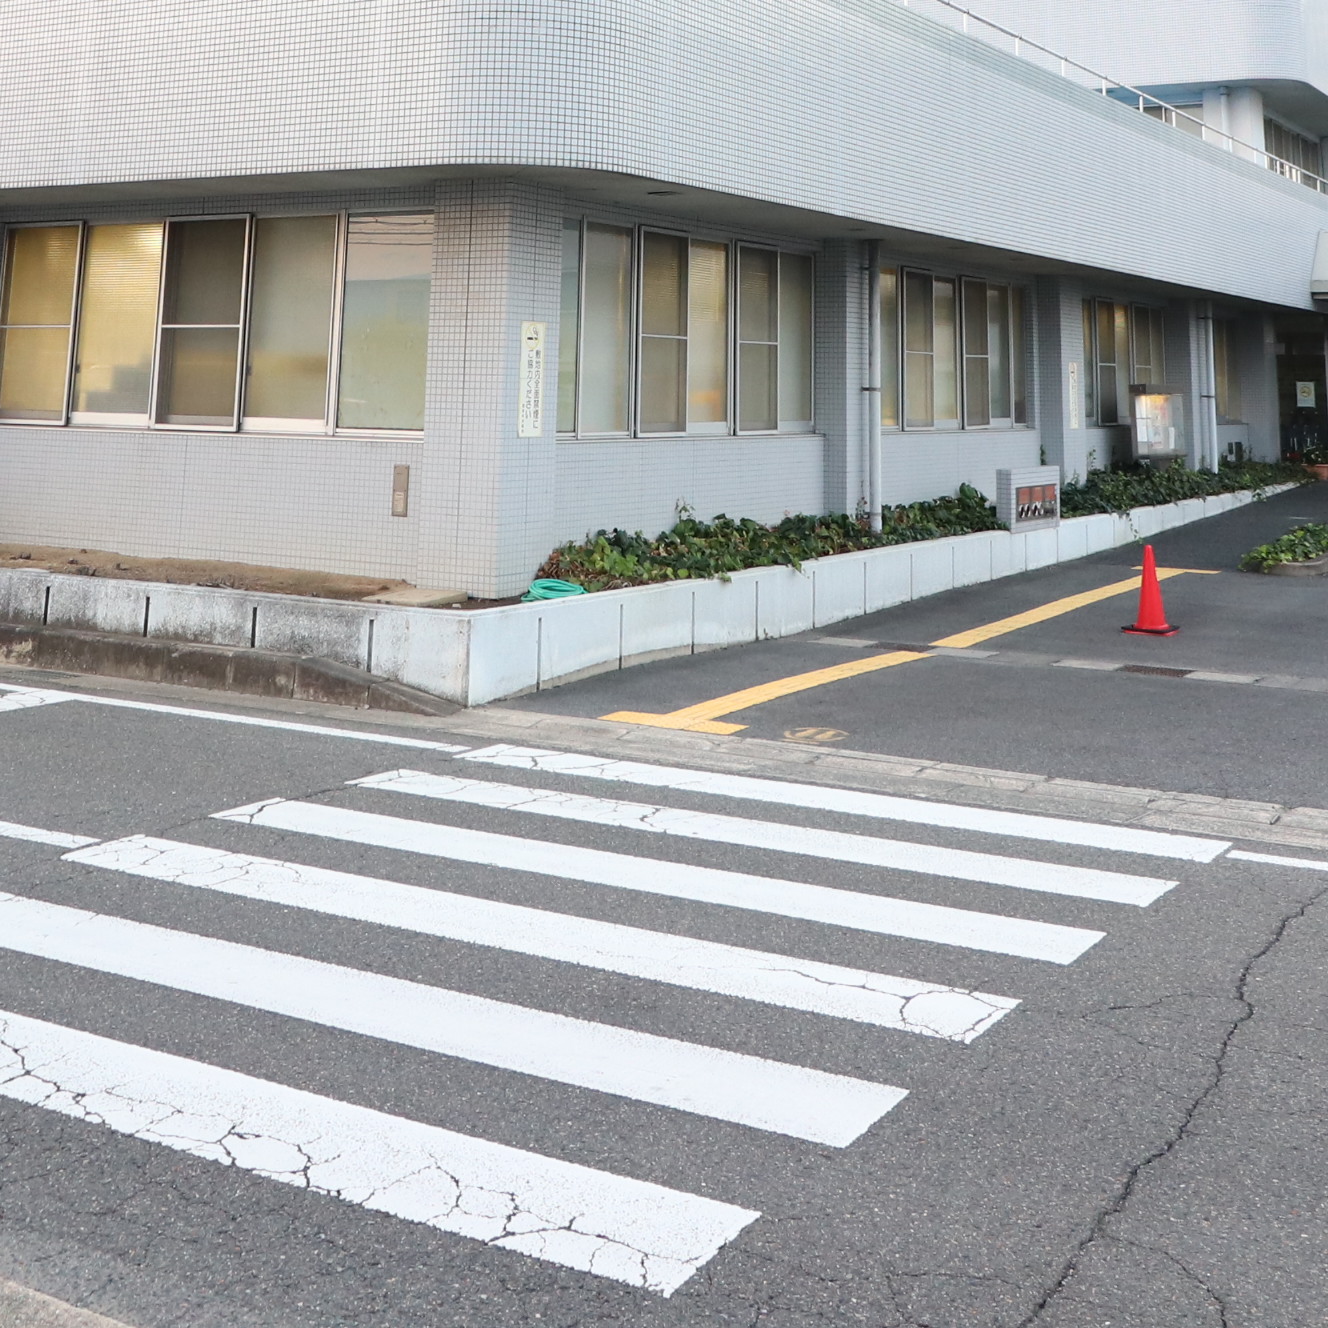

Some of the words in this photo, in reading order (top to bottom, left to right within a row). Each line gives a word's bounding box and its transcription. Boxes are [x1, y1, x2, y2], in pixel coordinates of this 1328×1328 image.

[525, 349, 534, 420] ご協力ください
[533, 349, 542, 429] 敷地内全面禁煙に
